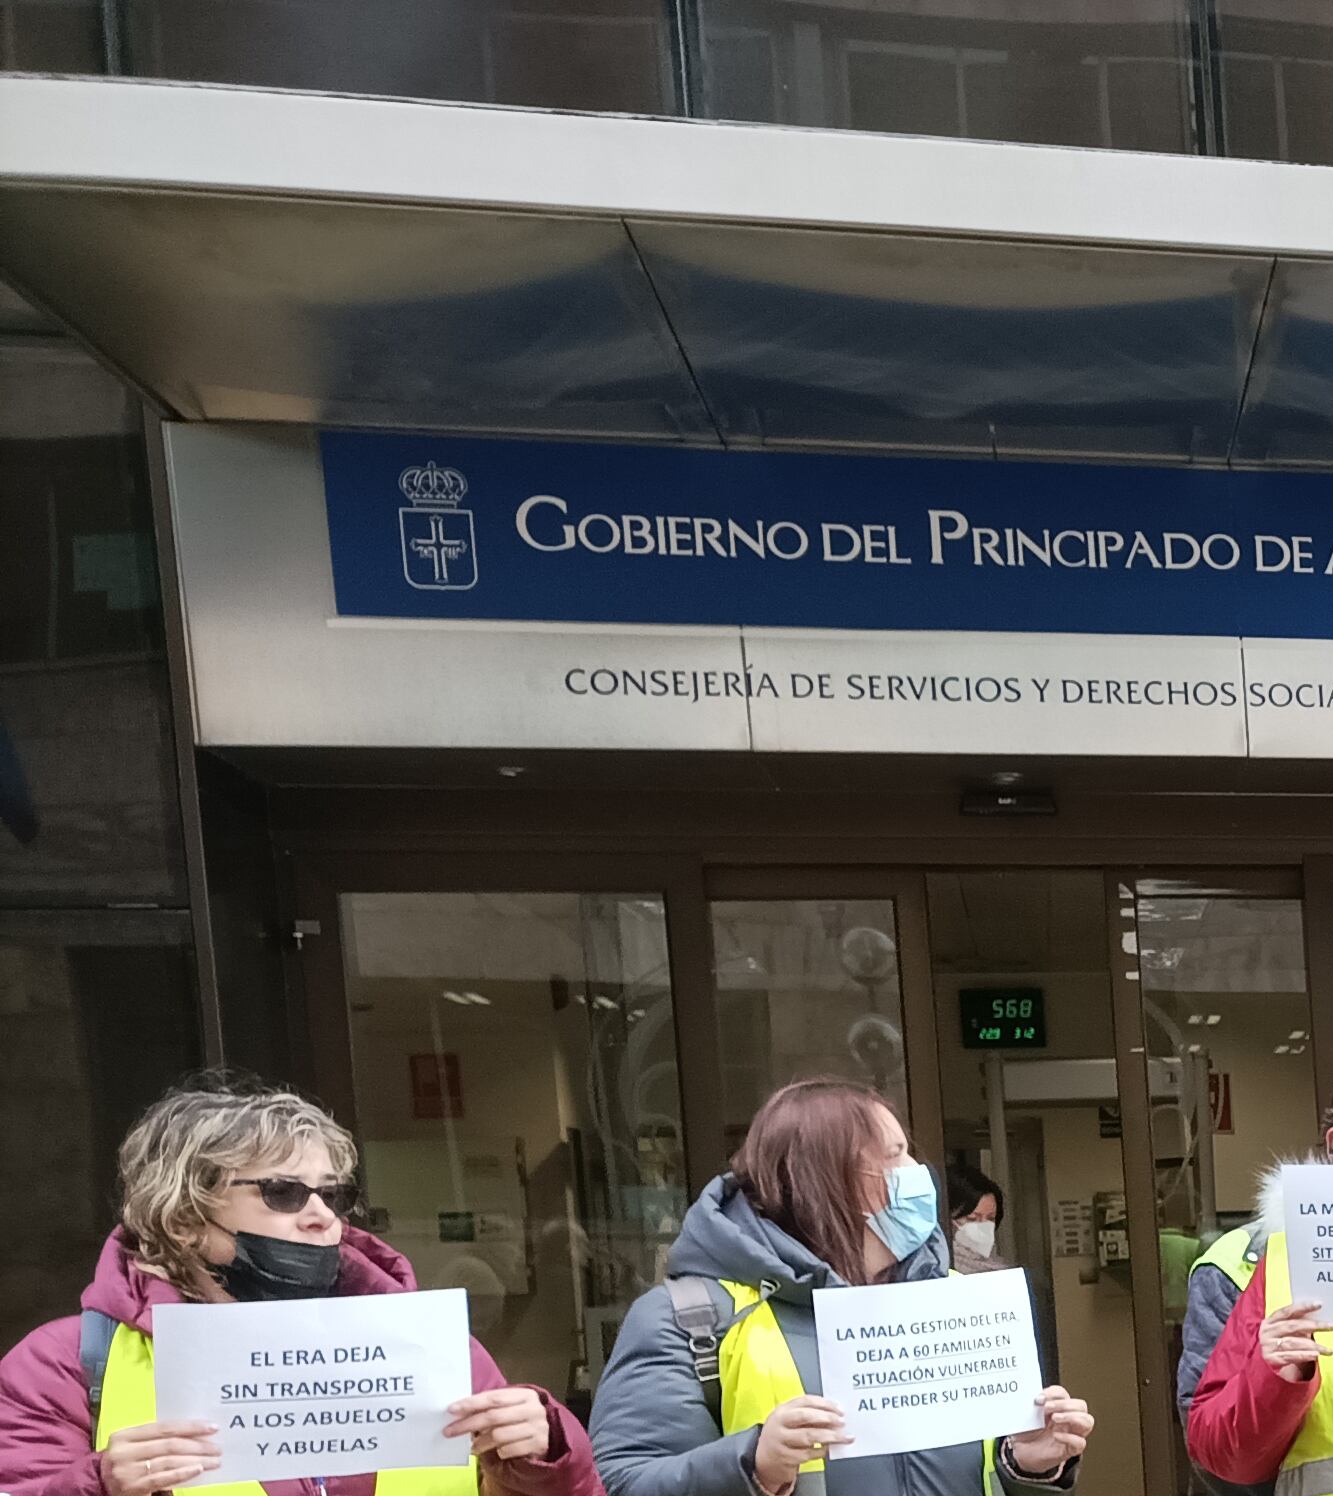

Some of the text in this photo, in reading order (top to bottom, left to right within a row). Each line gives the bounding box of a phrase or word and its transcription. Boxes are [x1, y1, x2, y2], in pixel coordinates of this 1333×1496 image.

[515, 494, 809, 559] GOBIERNO
[821, 523, 911, 564] DEL
[928, 510, 1240, 570] PRINCIPADO
[1254, 535, 1314, 573] DE
[564, 664, 779, 703] CONSEJERÍA
[791, 673, 835, 698] DE
[847, 674, 1021, 702] SERVICIOS
[1031, 679, 1050, 702] Y
[1062, 679, 1237, 706] DERECHOS
[992, 999, 1033, 1019] 568
[1299, 1203, 1317, 1216] LA
[836, 1328, 856, 1342] LA
[860, 1324, 906, 1339] MALA
[910, 1317, 967, 1335] GESTION
[970, 1314, 991, 1327] DEL
[250, 1345, 387, 1367] EL ERA DEJA
[856, 1334, 1011, 1363] DEJA A 60 FAMILIAS EN
[852, 1356, 1018, 1387] SITUACIÓN VULNERABLE
[220, 1376, 414, 1400] SIN TRANSPORTE
[857, 1380, 1019, 1412] AL PERDER SU TRABAJO
[229, 1407, 406, 1429] A LOS ABUELOS
[256, 1437, 378, 1456] Y ABUELAS
